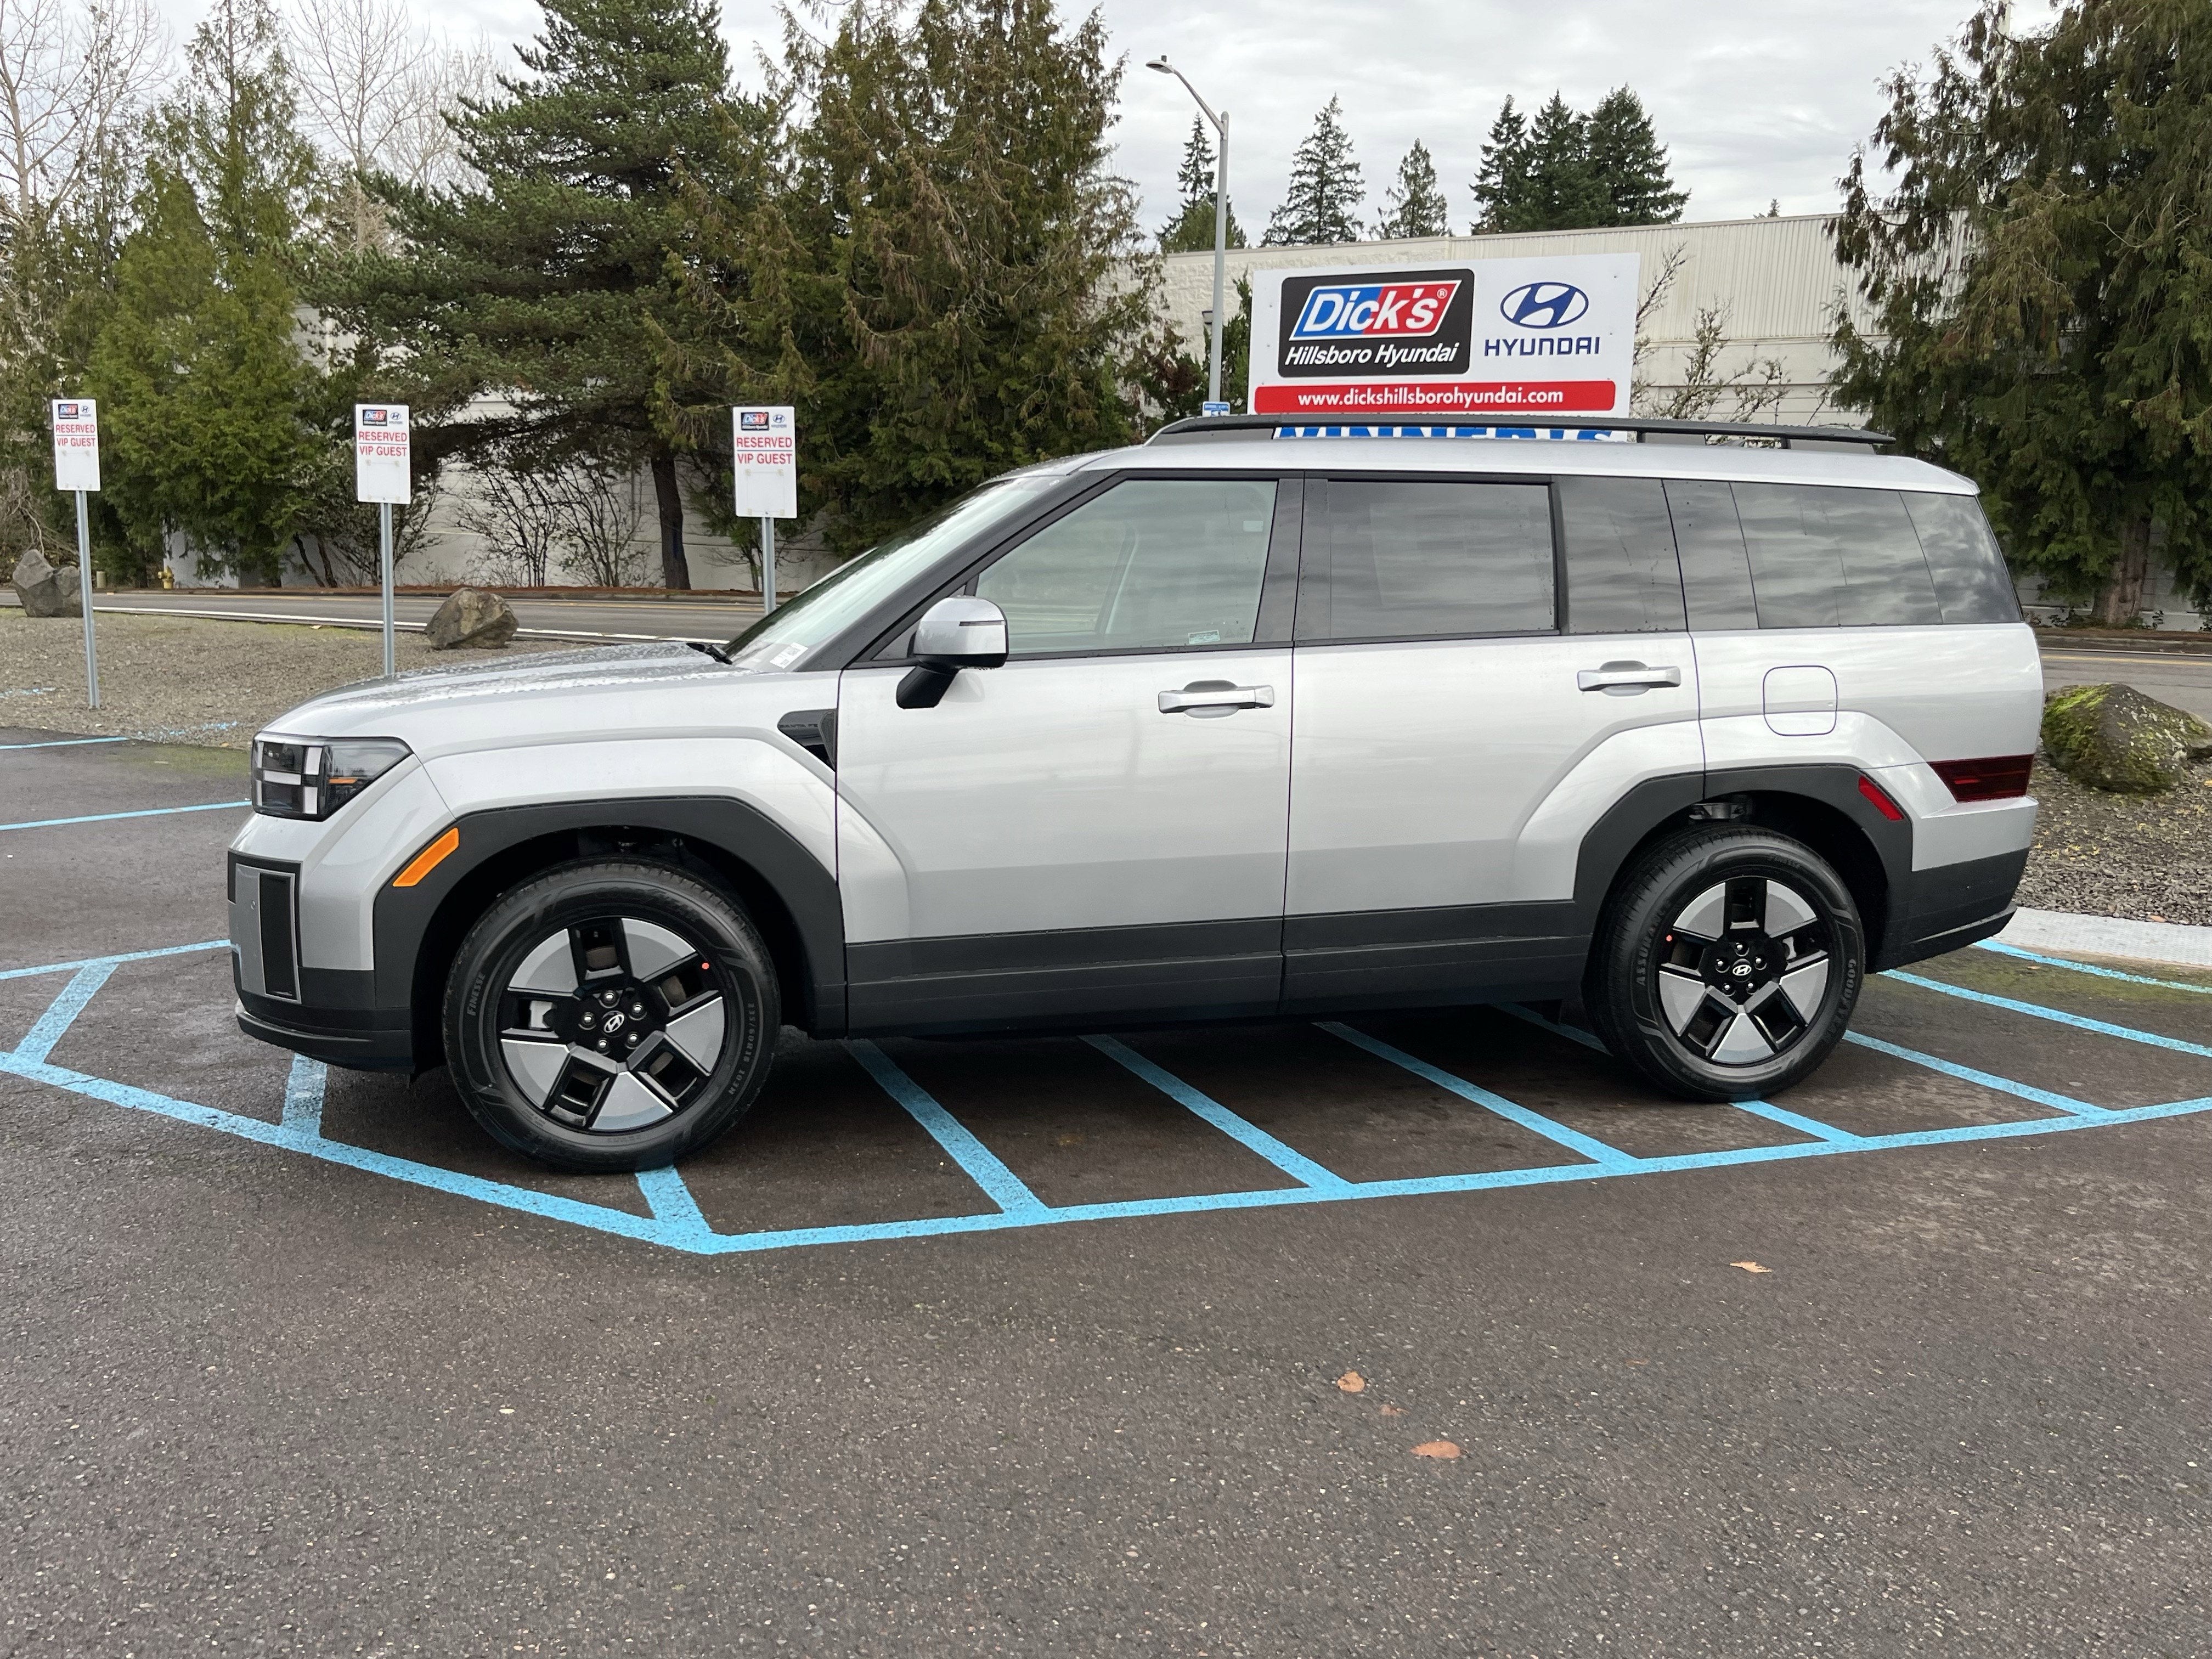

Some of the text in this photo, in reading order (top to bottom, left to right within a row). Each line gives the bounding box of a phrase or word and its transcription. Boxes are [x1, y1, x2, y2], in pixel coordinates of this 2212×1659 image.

[1302, 287, 1438, 332] Dick's
[1485, 336, 1600, 357] HYUNDAI
[1284, 342, 1460, 369] Hillsboro Hyundai
[1297, 386, 1564, 408] www.dickshillsborohyundai.com
[55, 424, 95, 433] RESERVED
[358, 431, 407, 442] RESERVED
[57, 438, 95, 447] VIP GUEST
[736, 437, 792, 448] RESERVED
[359, 445, 407, 456] VIP GUEST
[737, 454, 792, 464] VIP GUEST
